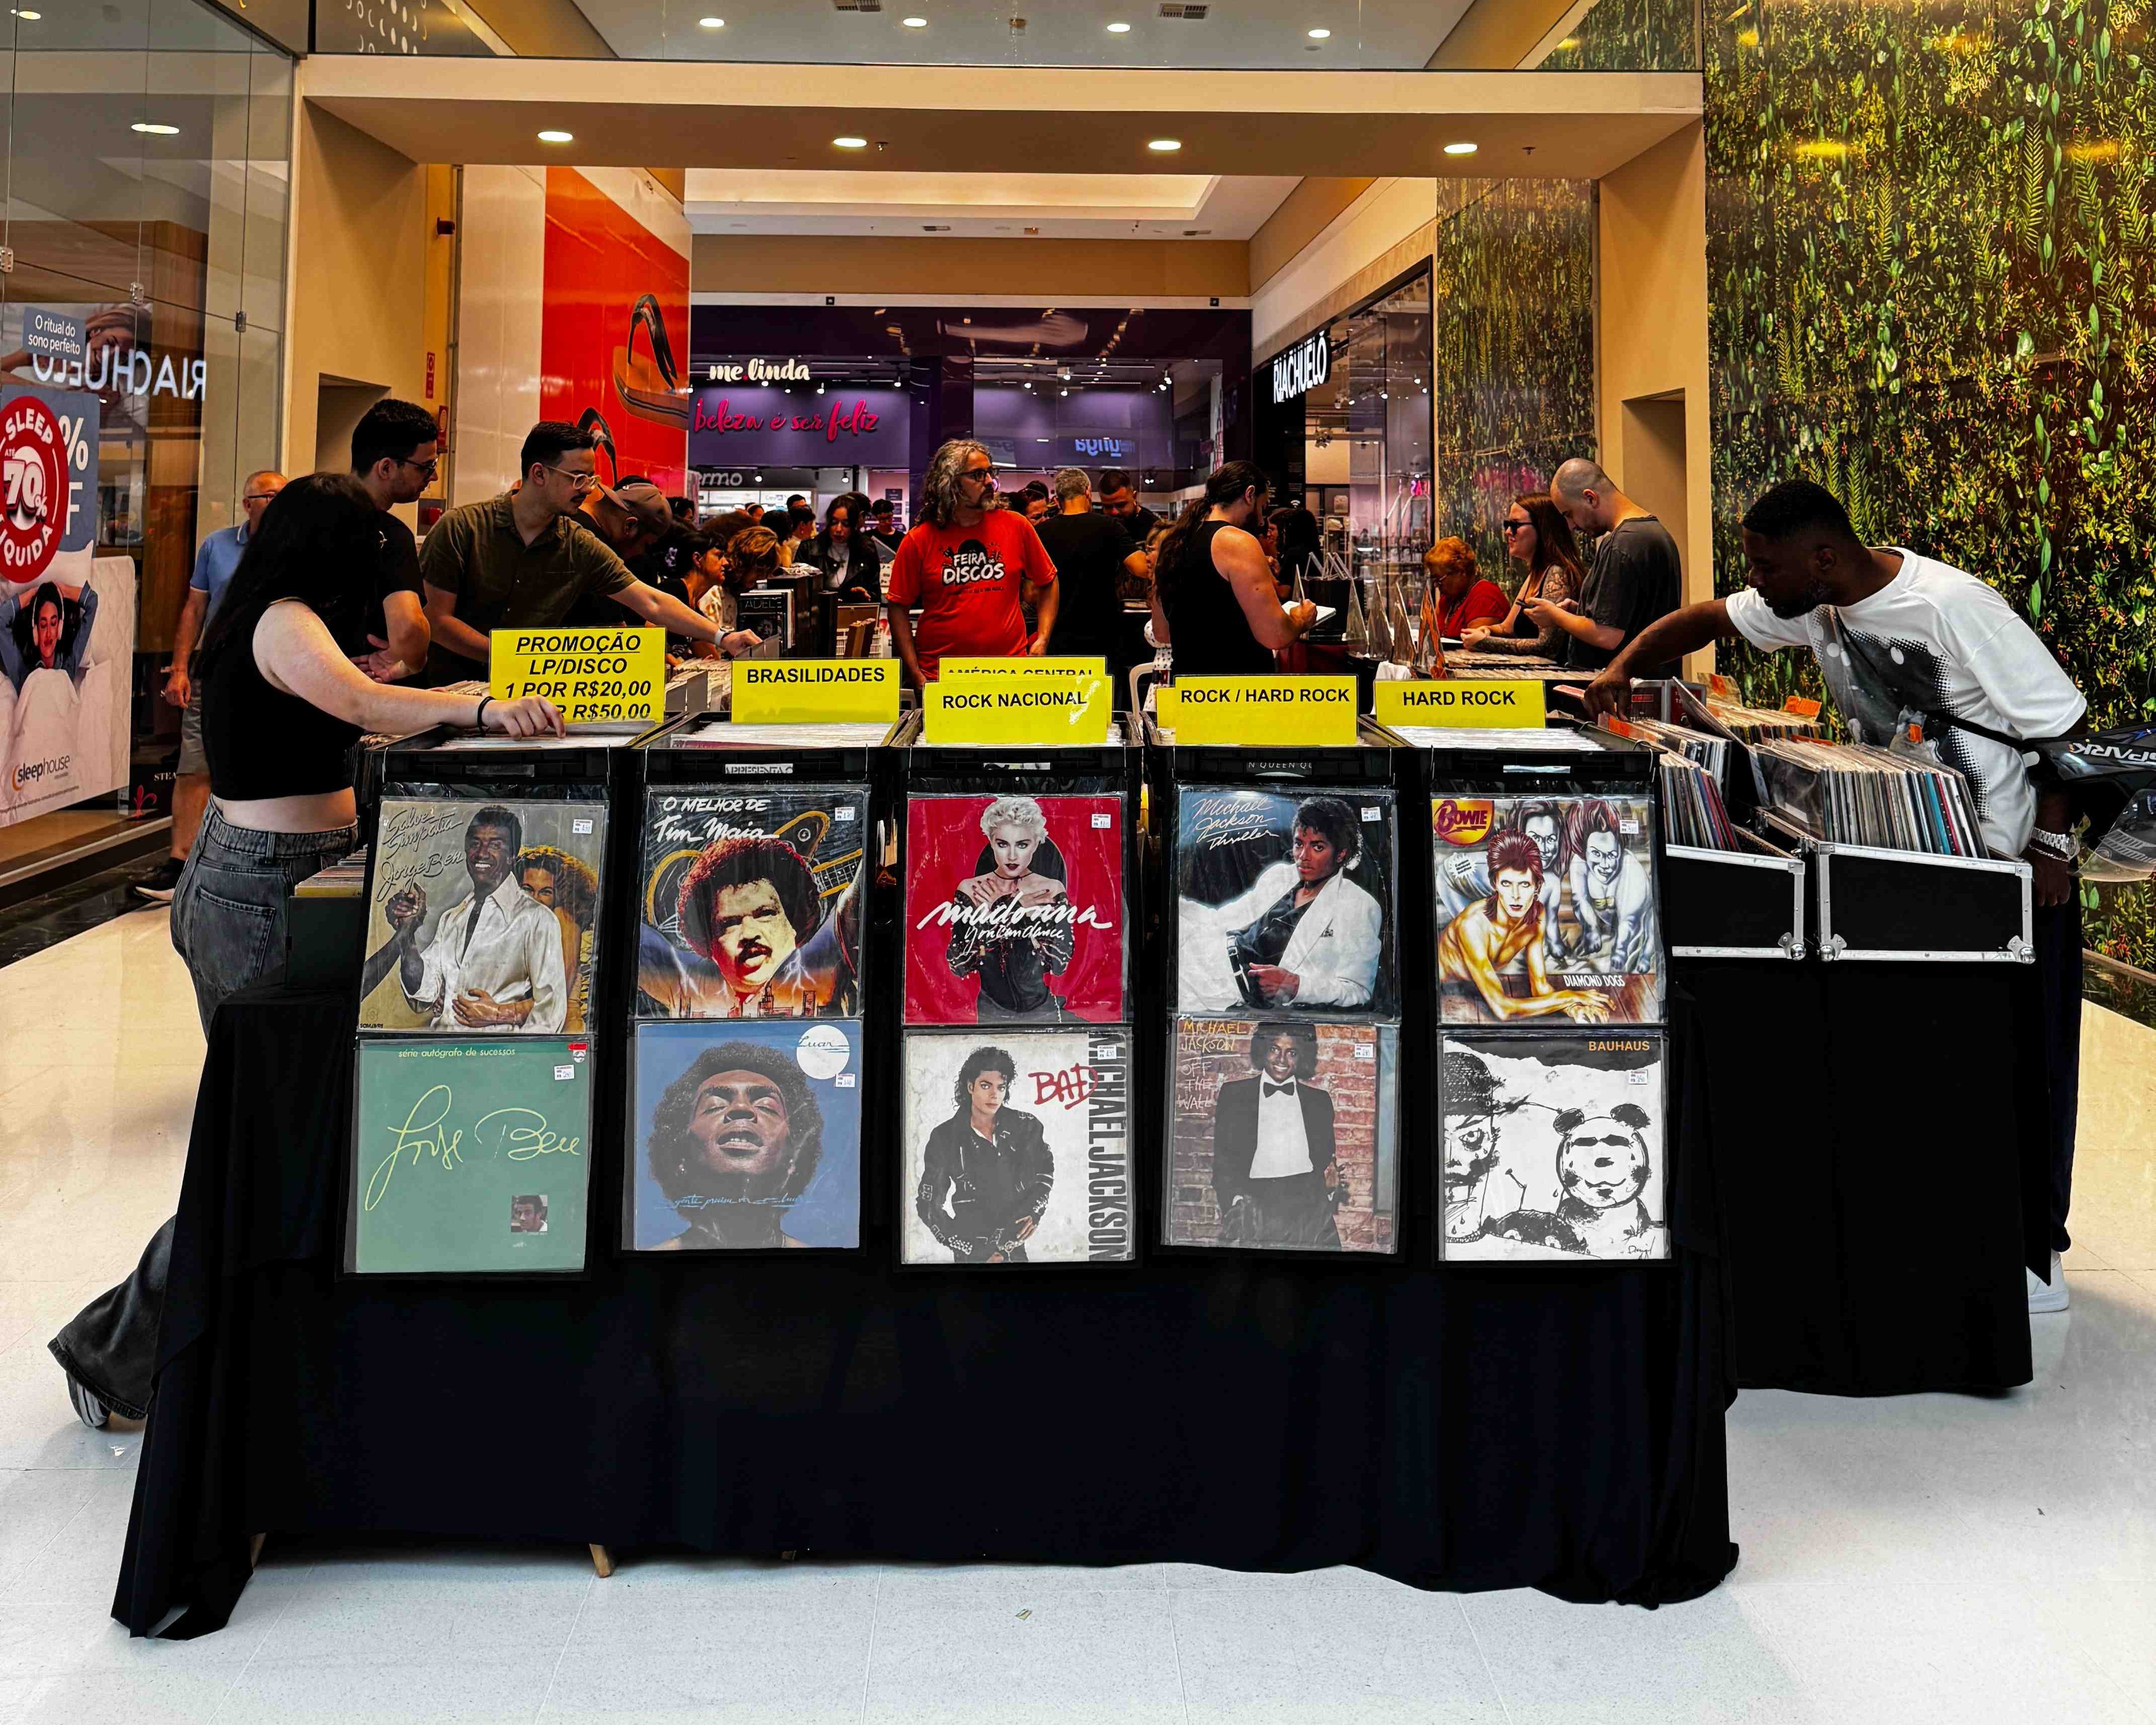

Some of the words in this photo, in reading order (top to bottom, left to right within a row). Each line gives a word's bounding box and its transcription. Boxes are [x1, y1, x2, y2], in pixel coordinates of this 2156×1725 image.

[35, 315, 42, 330] O
[44, 320, 64, 335] ritual
[65, 322, 75, 336] do
[28, 334, 48, 349] sono
[50, 338, 81, 355] perfeito
[1273, 331, 1328, 404] RIACHUELO
[6, 408, 53, 445] SLEEP
[694, 398, 764, 434] beleza
[769, 412, 787, 431] é
[791, 413, 825, 431] ser
[827, 399, 879, 442] feliz
[0, 514, 53, 567] IQUIDA
[954, 552, 987, 566] FEIRA
[943, 563, 1005, 584] DISCOS
[516, 632, 641, 654] PROMOÇÃO
[529, 658, 627, 675] LP/DISCO
[747, 667, 885, 684] BRASILIDADES
[505, 683, 514, 698] 1
[522, 682, 567, 698] POR
[573, 680, 651, 699] R$20,00
[943, 694, 992, 709] ROCK
[998, 691, 1088, 707] NACIONAL
[1181, 689, 1230, 703] ROCK
[1236, 689, 1241, 703] /
[1246, 689, 1294, 702] HARD
[1300, 689, 1350, 702] ROCK
[1403, 691, 1455, 706] HARD
[1461, 691, 1516, 705] ROCK
[573, 703, 651, 721] R$50,00
[663, 797, 677, 811] O
[681, 798, 742, 812] MELHOR
[745, 799, 771, 811] DE
[1193, 796, 1276, 819] Michael
[383, 807, 435, 845] Salve
[1434, 800, 1488, 834] BOWIE
[387, 813, 464, 860] Simpatia
[654, 814, 703, 843] Tim
[703, 817, 780, 840] Maia
[1195, 813, 1276, 843] Jackson
[1207, 829, 1280, 851] Thriller
[376, 861, 426, 902] Jorge
[423, 852, 464, 878] Ben
[916, 891, 1113, 930] madonna
[1563, 975, 1603, 987] DIAMOND
[1603, 975, 1626, 987] DOGS
[1183, 1020, 1247, 1035] MICHAEL
[798, 1036, 837, 1047] Luar
[1181, 1035, 1235, 1053] JACKSON
[1588, 1041, 1650, 1052] BAUHAUS
[399, 1047, 418, 1057] série
[421, 1047, 462, 1058] autógrafo
[466, 1047, 477, 1056] de
[480, 1047, 516, 1056] sucessos
[1181, 1061, 1212, 1077] OFF
[1028, 1062, 1099, 1110] BAD
[1088, 1032, 1127, 1144] MICHAEL
[1185, 1076, 1213, 1092] THE
[1178, 1093, 1213, 1110] WALL
[1088, 1146, 1127, 1262] JACKSON
